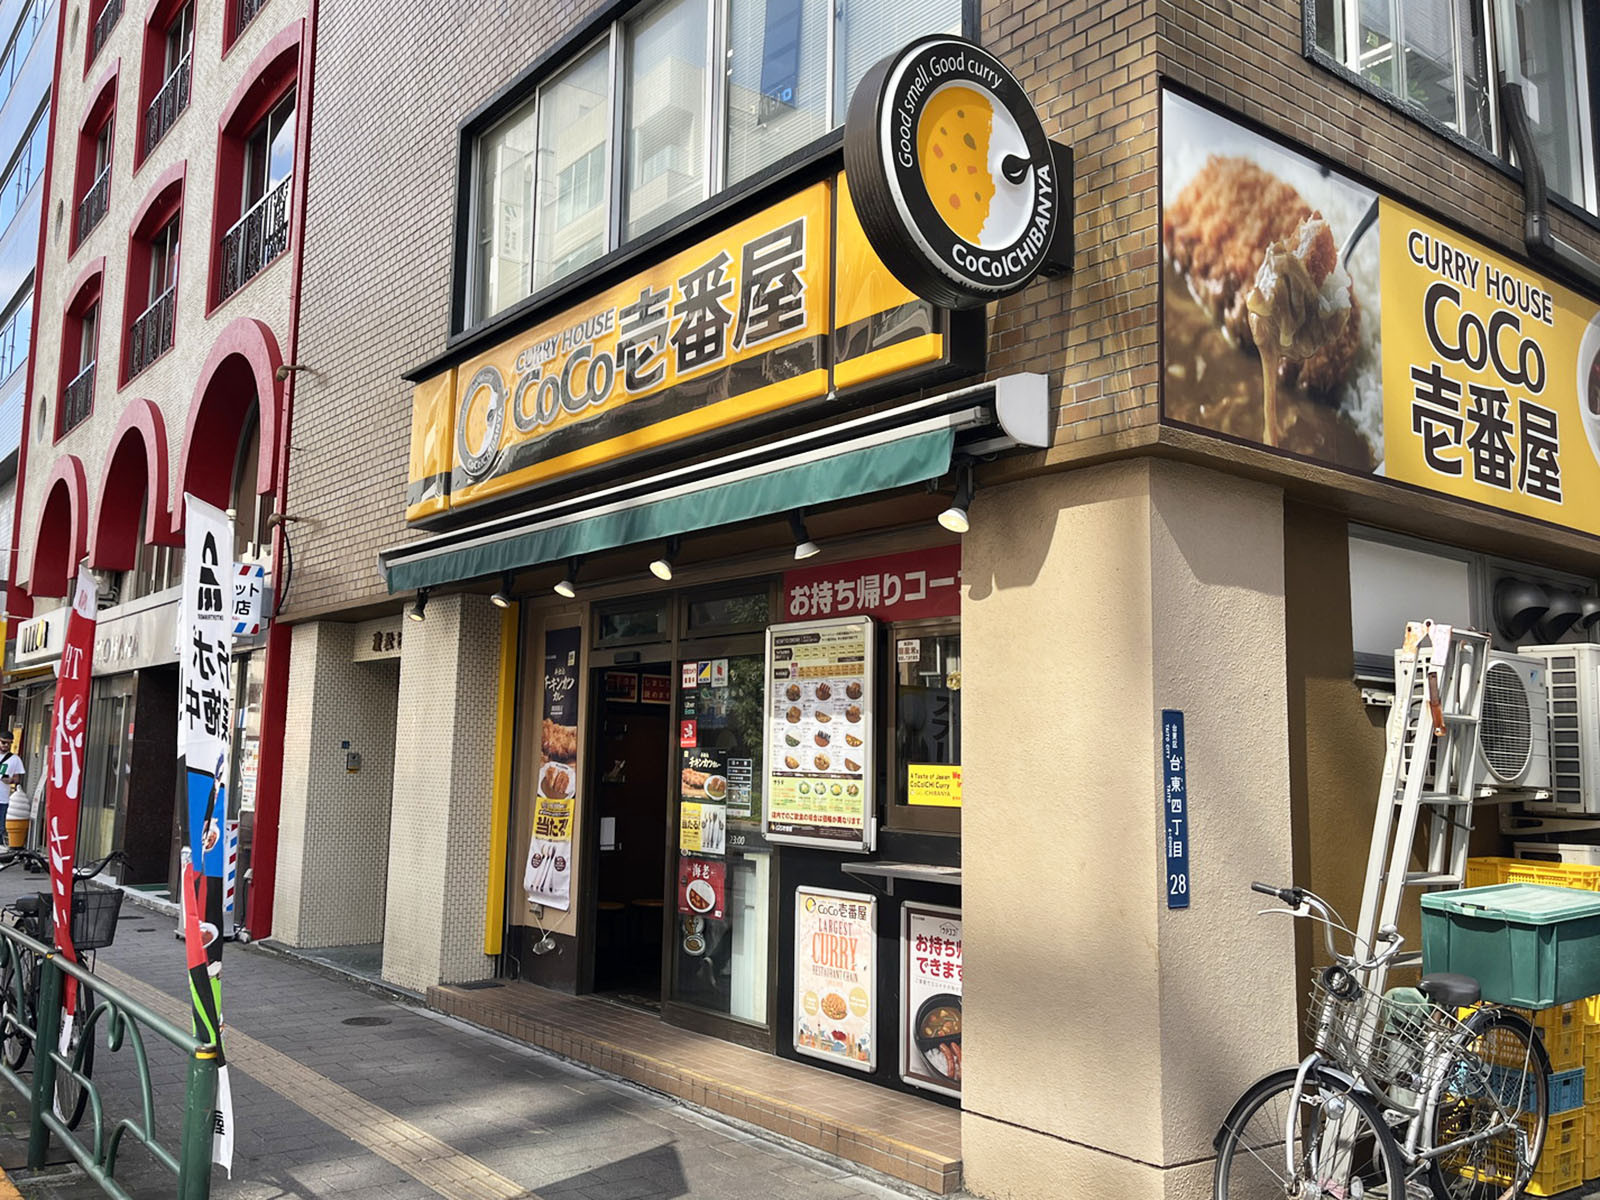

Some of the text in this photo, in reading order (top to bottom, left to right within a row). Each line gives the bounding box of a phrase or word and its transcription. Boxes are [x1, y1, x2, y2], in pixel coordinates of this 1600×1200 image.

[898, 52, 1003, 169] Good smell. Good curry
[1407, 229, 1554, 326] CURRY HOUSE
[516, 307, 616, 372] CURRY HOUSE
[1423, 281, 1546, 394] CoCo
[1410, 363, 1564, 505] 壱番屋
[789, 569, 962, 617] お持ち帰りコー
[1169, 754, 1186, 895] 台東四丁目 28
[811, 932, 859, 972] CURRY
[818, 918, 853, 937] LARGEST
